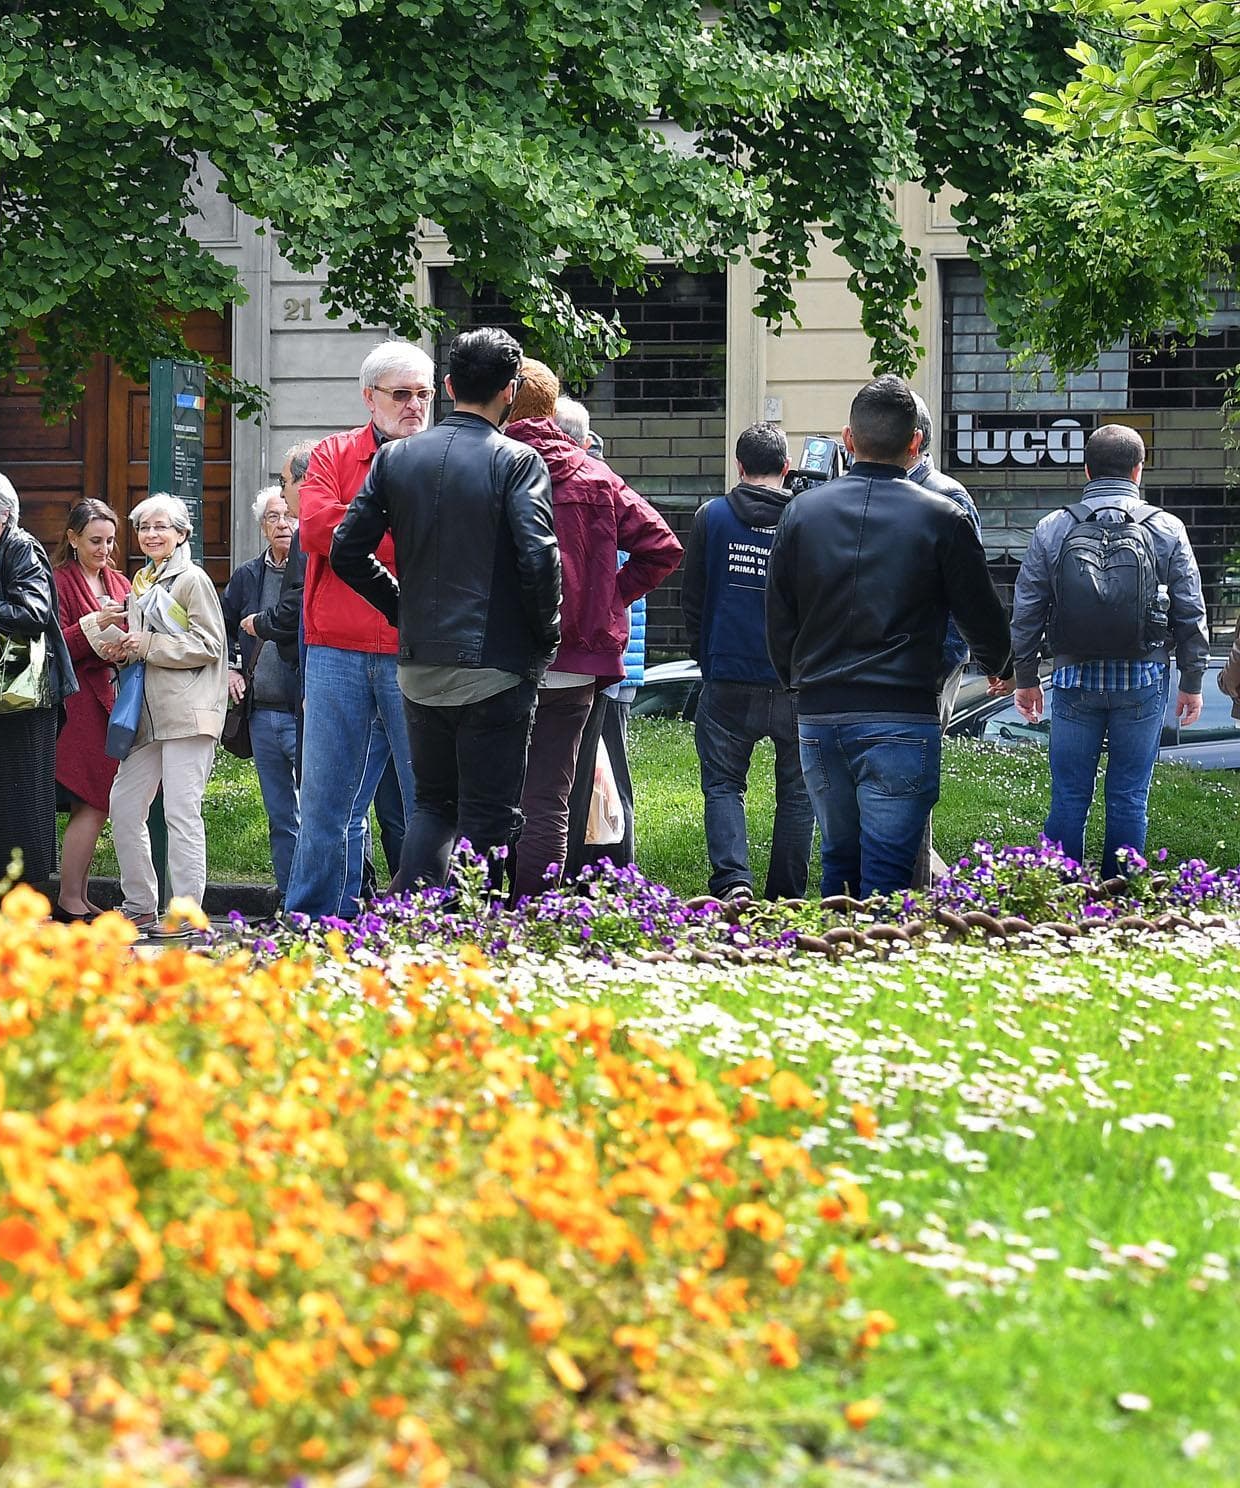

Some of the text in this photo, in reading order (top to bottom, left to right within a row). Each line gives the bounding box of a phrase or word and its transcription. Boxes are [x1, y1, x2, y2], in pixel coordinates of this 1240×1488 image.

[283, 297, 312, 321] 21
[957, 414, 1085, 465] luca
[729, 554, 765, 566] PRIMA DI
[729, 565, 766, 576] PRIMA DI
